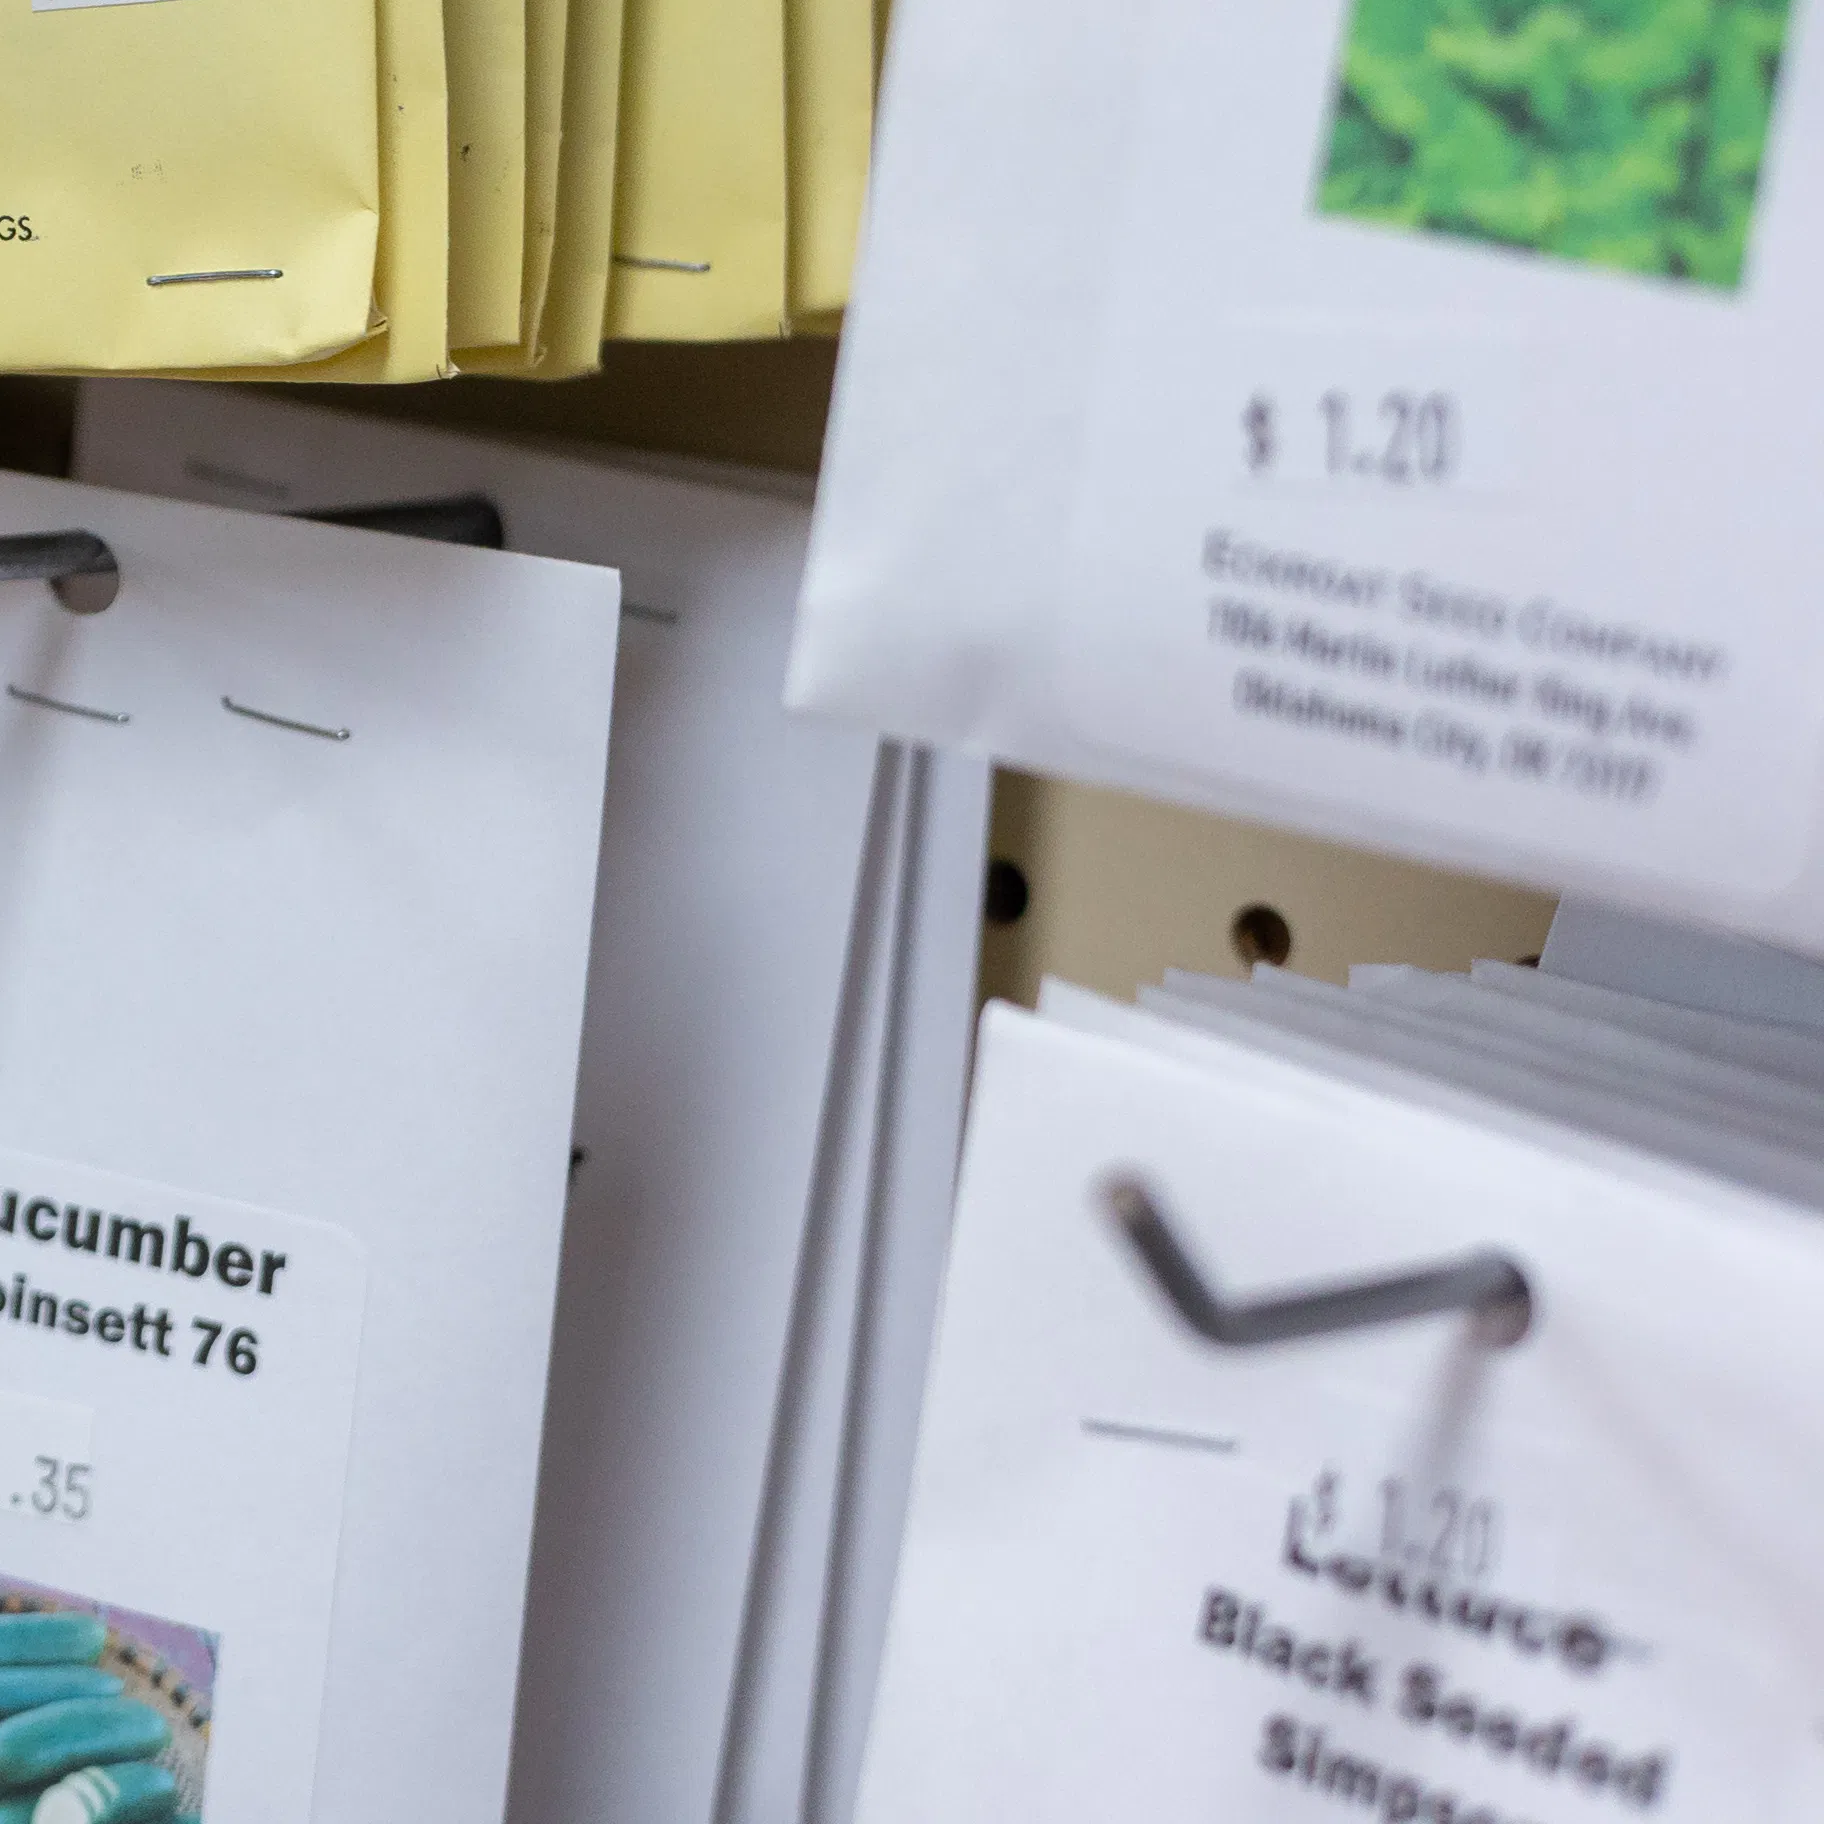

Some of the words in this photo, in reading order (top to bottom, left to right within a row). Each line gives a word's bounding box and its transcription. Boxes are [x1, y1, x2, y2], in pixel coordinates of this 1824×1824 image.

[190, 1315, 261, 1378] 76
[1199, 1582, 1376, 1706] Black
[1399, 1661, 1672, 1808] Seeded
